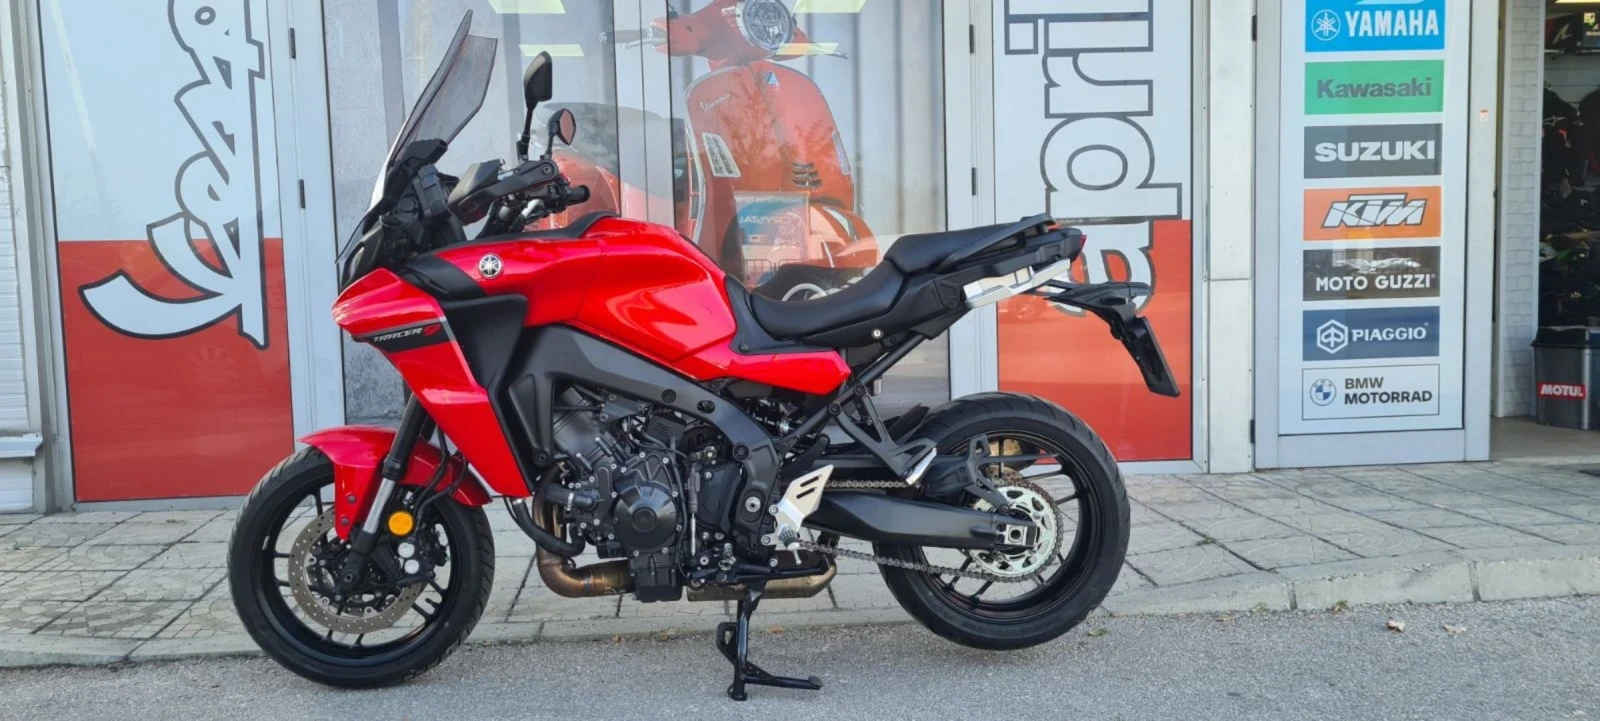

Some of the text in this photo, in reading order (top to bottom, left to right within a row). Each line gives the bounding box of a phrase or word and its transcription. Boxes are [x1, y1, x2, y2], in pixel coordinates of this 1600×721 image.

[1345, 9, 1439, 37] YAMAHA
[1316, 77, 1432, 99] Kawasaki
[1314, 140, 1435, 162] SUZUKI
[1321, 192, 1428, 228] KTM
[1316, 273, 1431, 291] MOTO GUZZI
[372, 327, 423, 343] TRACER
[1351, 326, 1427, 342] PIAGGIO
[1344, 377, 1384, 390] BMW
[1540, 384, 1584, 397] MOTUL
[1344, 390, 1433, 405] MOTORRAD
